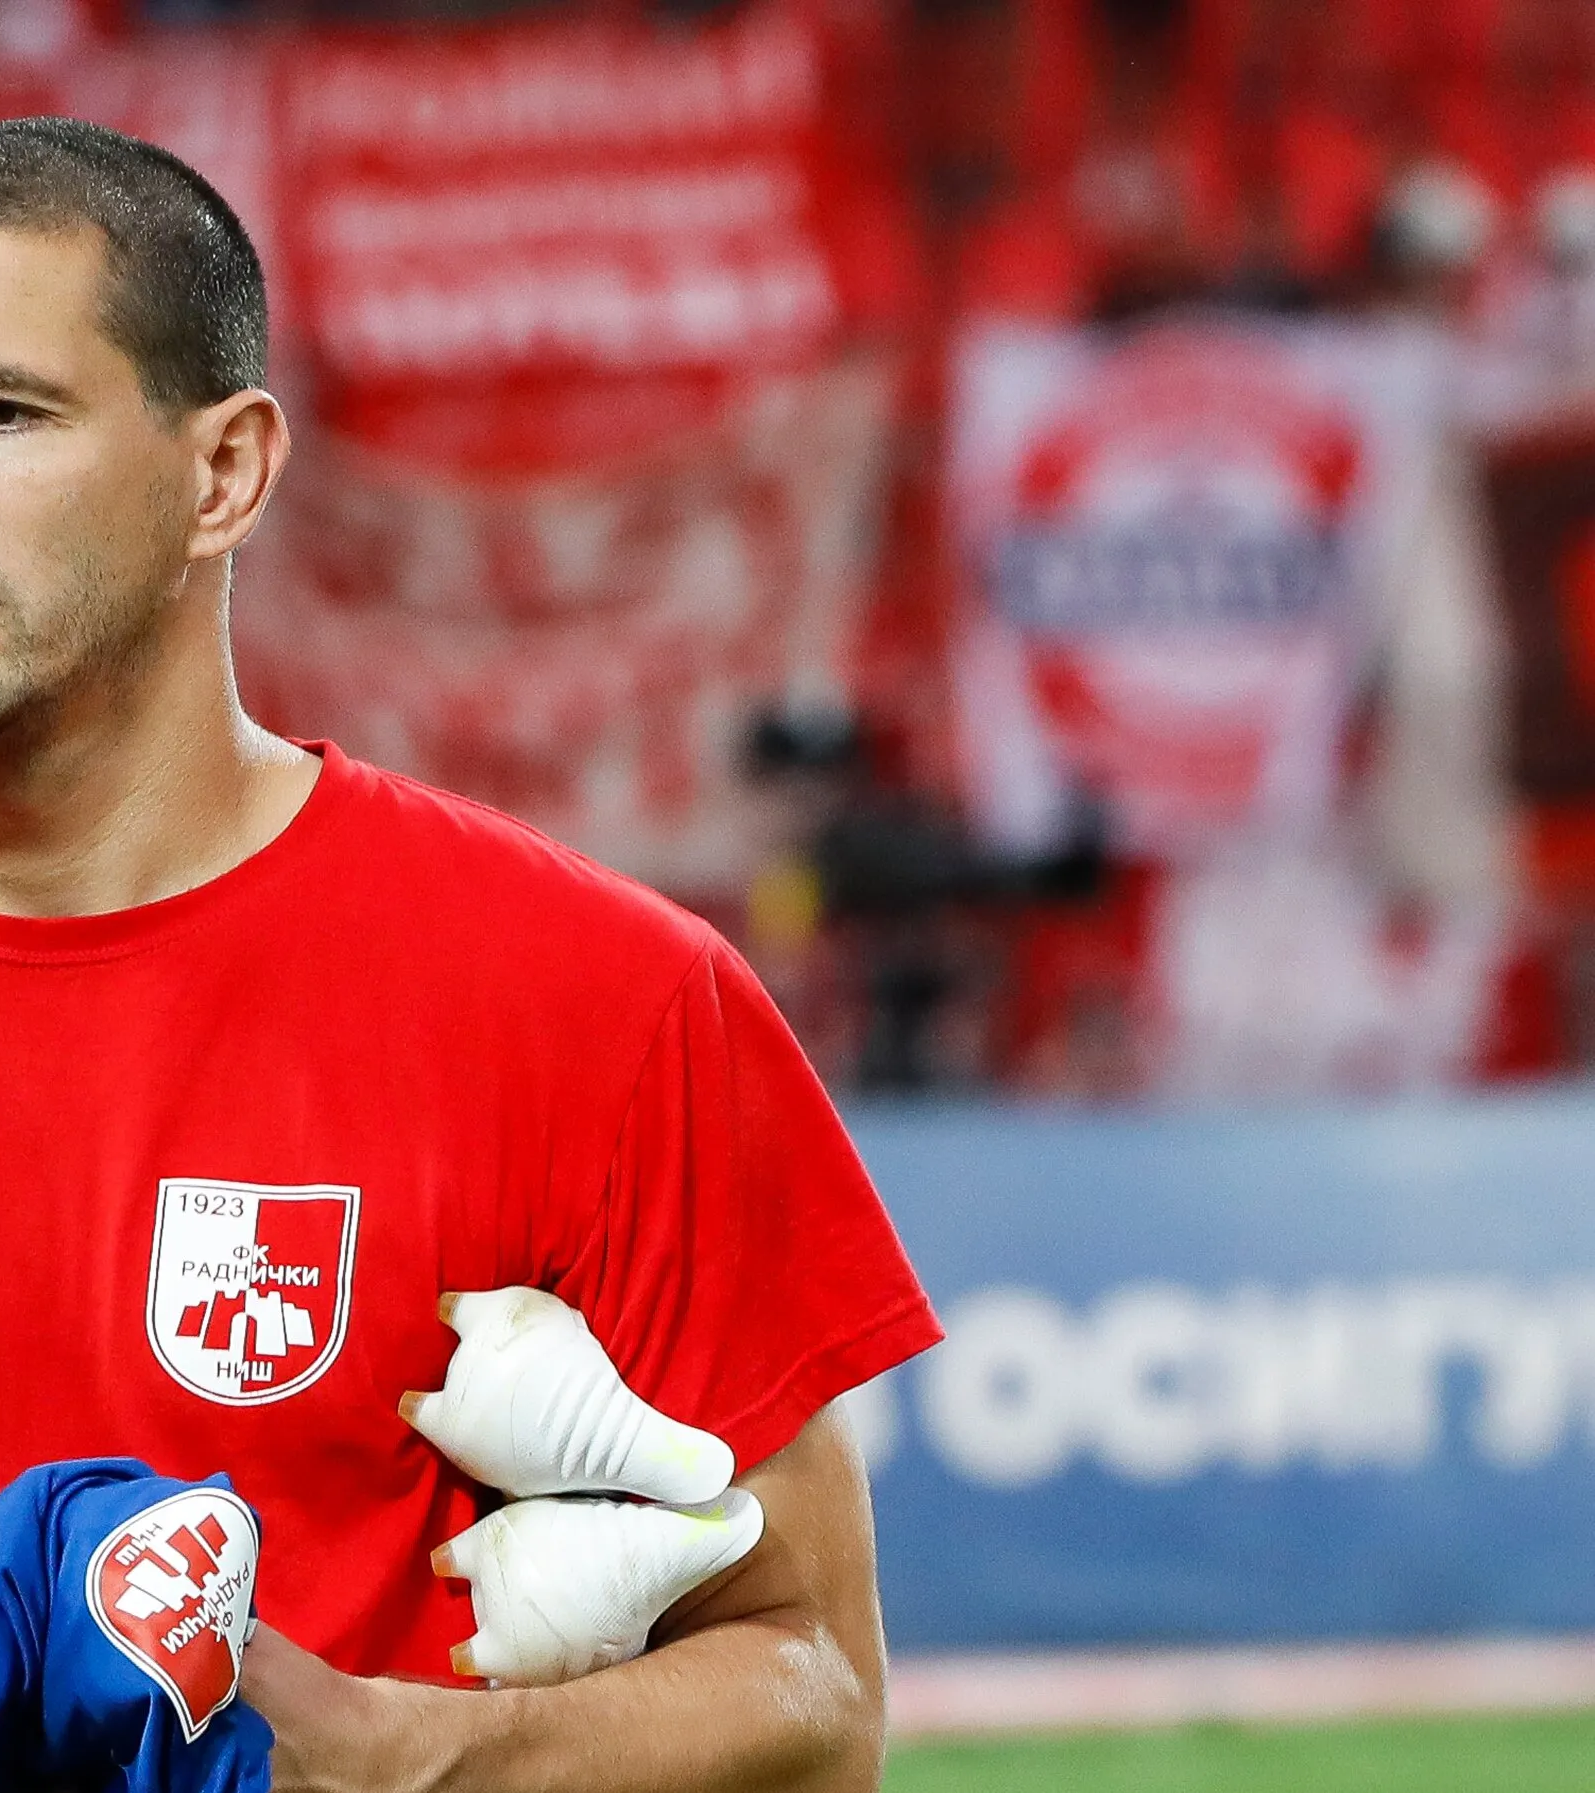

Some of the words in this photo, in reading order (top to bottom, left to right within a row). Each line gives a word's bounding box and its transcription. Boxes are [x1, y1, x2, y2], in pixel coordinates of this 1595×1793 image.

[179, 1192, 245, 1218] 1923
[232, 1244, 271, 1264] ФК
[181, 1260, 320, 1287] РАДНИЧКИ
[216, 1361, 273, 1381] НИШ
[115, 1522, 163, 1566] НИШ
[160, 1561, 251, 1655] РАДНИЧКИ
[209, 1611, 234, 1642] ФК
